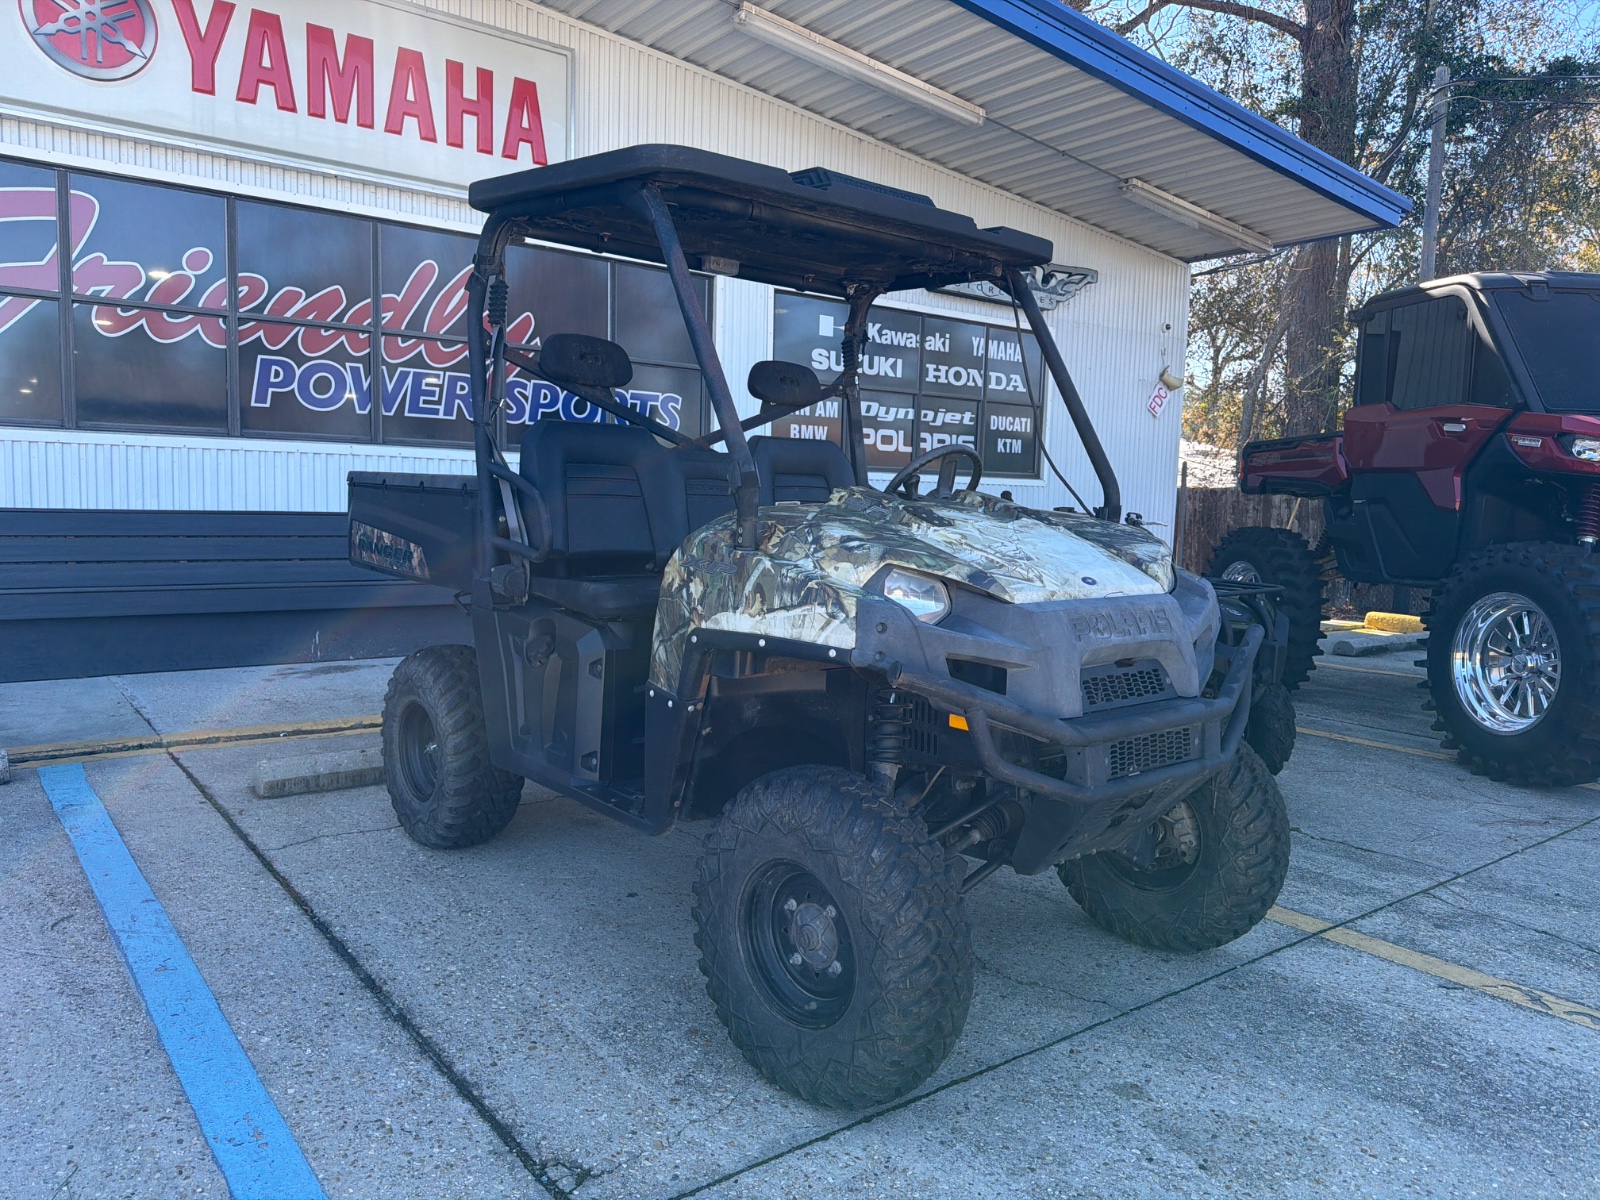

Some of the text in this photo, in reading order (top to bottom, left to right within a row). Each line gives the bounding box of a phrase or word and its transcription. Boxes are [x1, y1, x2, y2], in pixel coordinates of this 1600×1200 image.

[172, 0, 548, 166] YAMAHA
[0, 187, 541, 402] Friendly
[971, 336, 1023, 363] YAMAHA
[811, 348, 903, 378] SUUKI
[925, 363, 1027, 392] HONDA
[815, 401, 838, 418] AM
[861, 401, 976, 427] Dynojet
[1149, 387, 1168, 415] FDC
[790, 424, 828, 441] BMW
[990, 415, 1030, 432] DUCATI
[997, 438, 1022, 453] KTM
[358, 537, 414, 563] RANGER
[680, 554, 737, 574] XP
[1069, 608, 1172, 641] POLARIS
